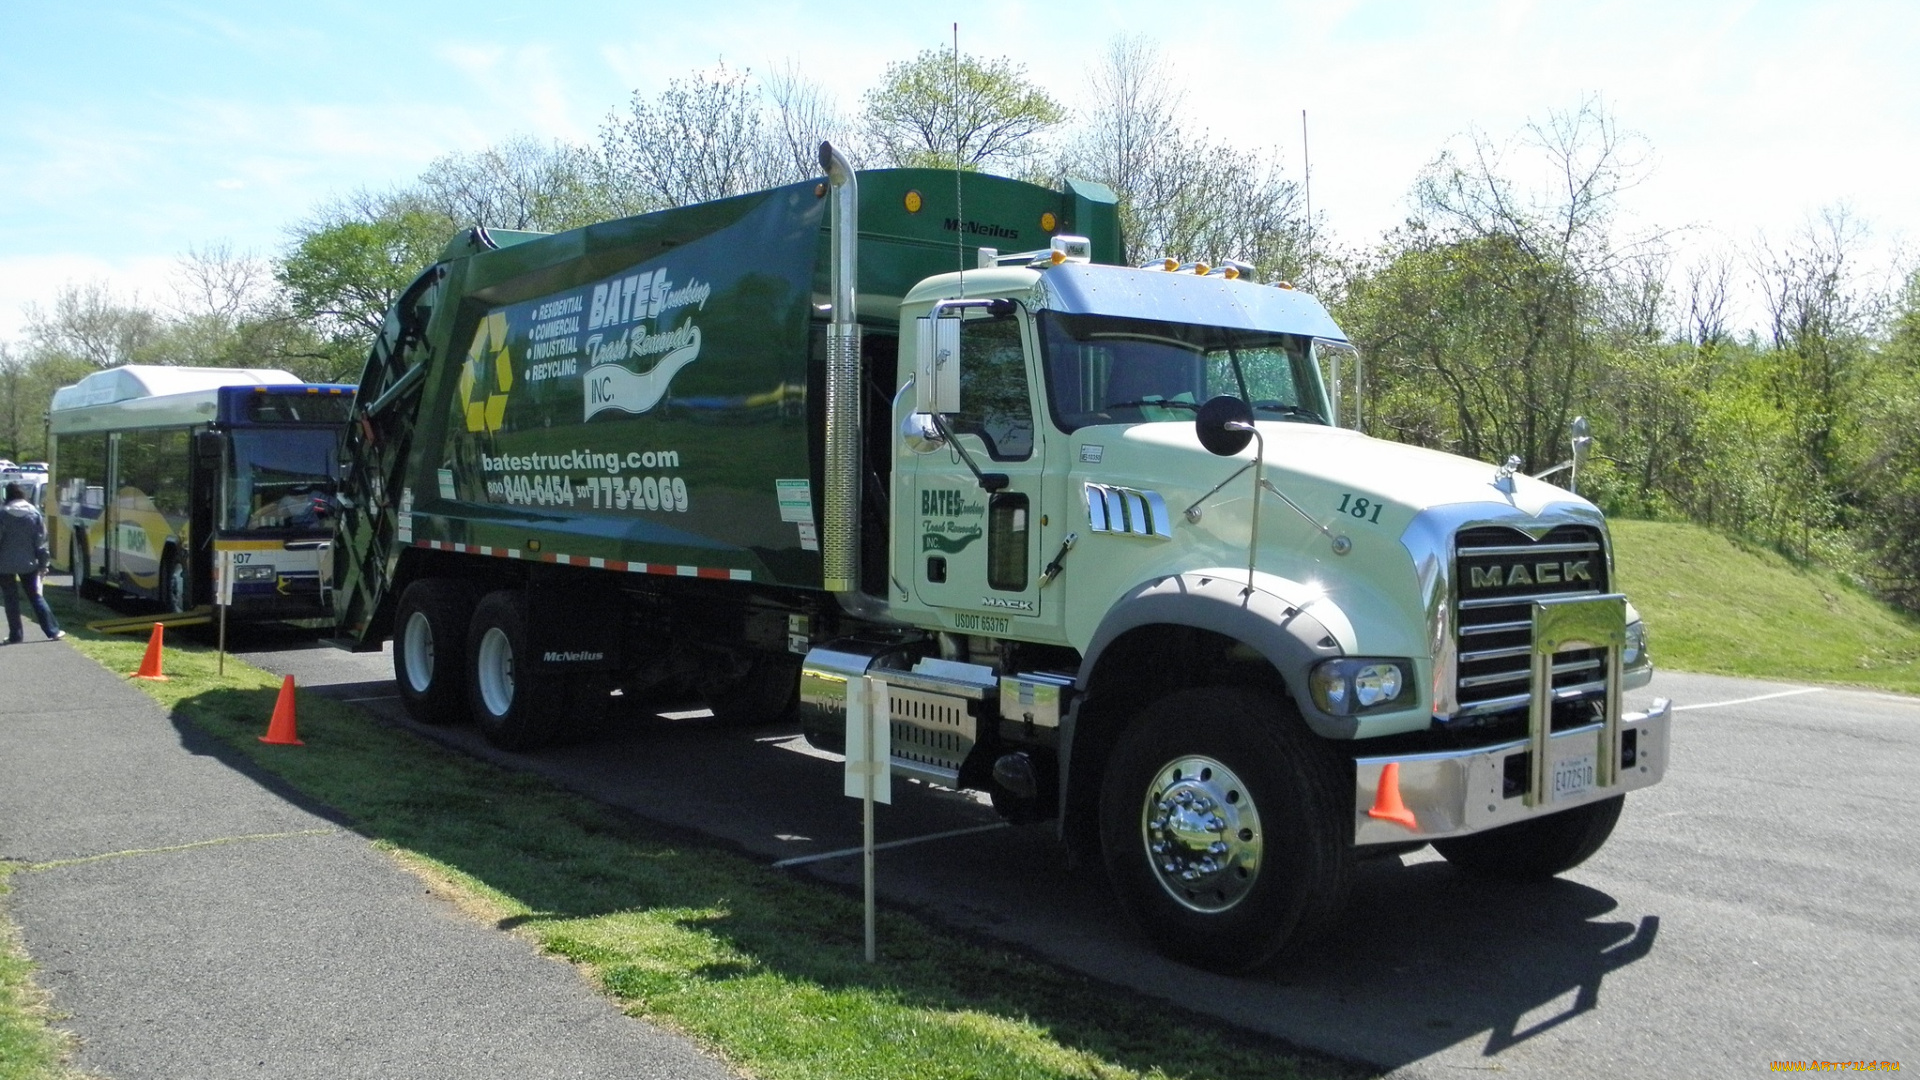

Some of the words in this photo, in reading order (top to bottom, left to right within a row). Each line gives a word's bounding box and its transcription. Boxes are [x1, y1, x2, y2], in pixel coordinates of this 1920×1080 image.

[943, 218, 1019, 239] McNeilus
[538, 295, 583, 321] RESIDENTIAL
[588, 267, 668, 330] BATES
[535, 316, 580, 341] COMMERCIAL
[533, 336, 578, 360] INDUSTRIAL
[532, 357, 577, 381] RECYCLING
[591, 376, 615, 404] INC.
[482, 449, 679, 474] batestrucking.com
[488, 481, 503, 497] 800
[503, 475, 575, 507] 840-6454
[576, 485, 590, 499] 301
[587, 476, 689, 512] 773-2069
[922, 490, 961, 517] BATES
[1336, 494, 1383, 525] 181
[926, 537, 940, 548] INC.
[1471, 561, 1592, 588] MACK
[982, 596, 1034, 612] MACK
[954, 613, 980, 630] USDOT
[981, 615, 1009, 633] 653767
[543, 651, 604, 662] McNeilus
